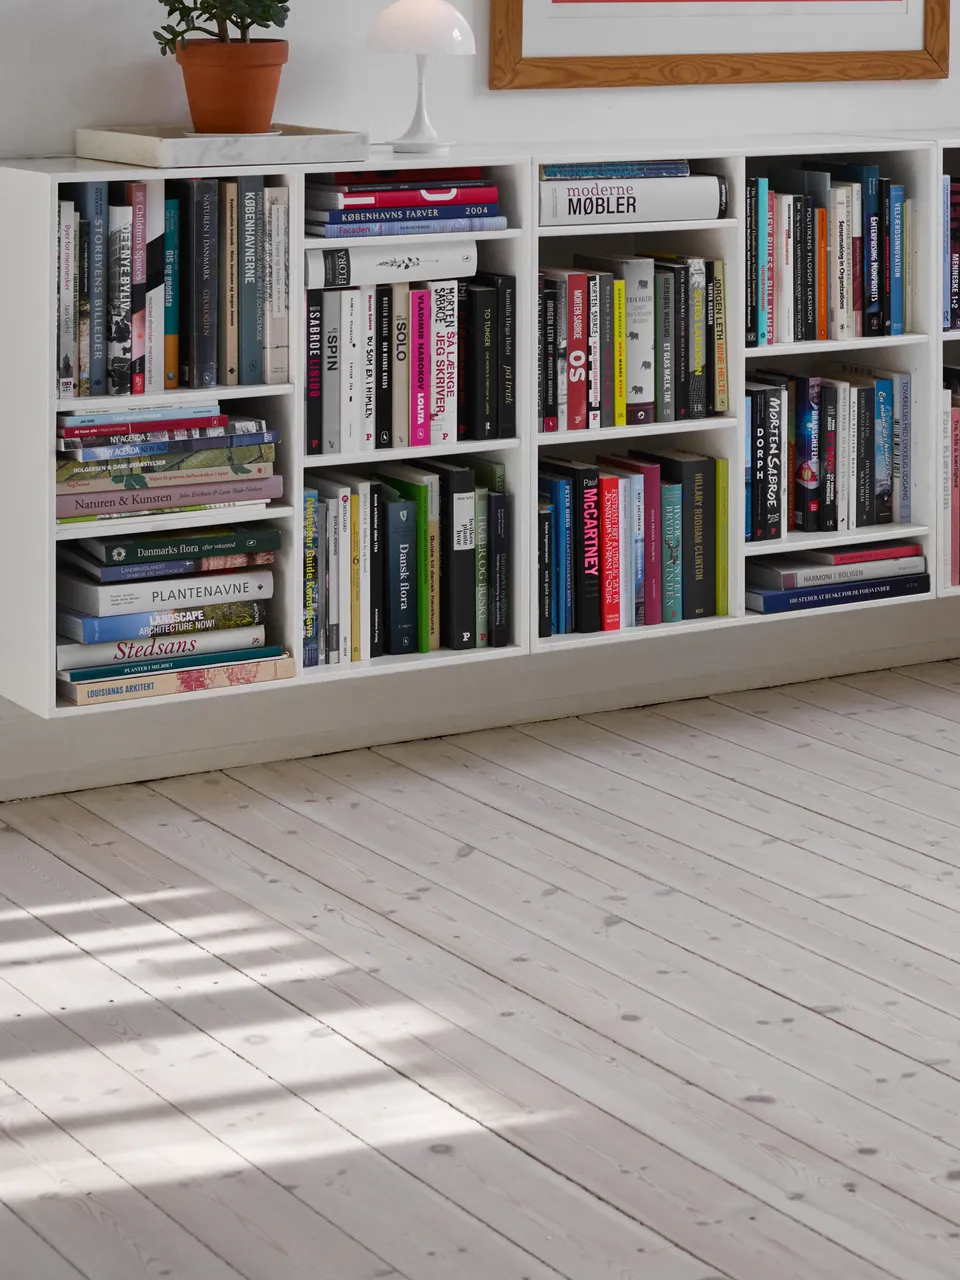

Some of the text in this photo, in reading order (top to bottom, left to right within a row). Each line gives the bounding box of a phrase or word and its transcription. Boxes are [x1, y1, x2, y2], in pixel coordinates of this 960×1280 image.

[567, 183, 634, 197] moderne
[568, 196, 637, 215] MØBLER
[339, 226, 371, 234] Facaden
[341, 207, 488, 221] KØBENHAVNS FARVER 2004
[63, 224, 72, 291] Byer for mennesker
[134, 205, 144, 281] Children's Spaces
[165, 250, 174, 262] GIS
[244, 192, 255, 284] KØBENHAVNERNE
[838, 220, 846, 259] Sensemaking
[120, 224, 131, 310] DET NYE BYLIV
[337, 250, 347, 284] FLORA
[94, 219, 103, 359] STORBYENS BILLEDER
[164, 276, 173, 307] geodata
[434, 287, 446, 324] SABROE
[444, 287, 455, 328] MORTEN
[714, 276, 722, 315] JØRGEN
[837, 268, 846, 310] Organizations
[951, 295, 959, 309] 1+2
[64, 317, 72, 334] Gehl
[484, 308, 491, 319] TO
[309, 312, 320, 397] SABROE LIBIDO
[327, 335, 338, 371] SPIN
[396, 322, 406, 361] SOLO
[569, 289, 586, 383] MORTEN SABROE OS
[694, 323, 702, 375] LARSSON
[435, 332, 445, 413] JEG SKRIVER
[446, 331, 456, 398] SÅ LÆNGE
[767, 397, 780, 508] MORTEN SABROE
[75, 493, 172, 510] Naturen & Kunsten
[604, 490, 612, 533] JONATHAN
[461, 524, 469, 545] plante
[583, 488, 599, 576] McCARTNEY
[694, 473, 703, 580] HILLARY RODHAM CLINTON
[305, 497, 315, 637] Arkitektur Guide København
[399, 543, 410, 610] Dansk flora
[478, 516, 487, 622] TRÆER OG BUSKE
[152, 582, 250, 602] PLANTENAVNE
[138, 619, 215, 636] ARCHITECTURE NOW!
[149, 610, 204, 624] LANDSCAPE
[113, 638, 197, 661] Stedsans
[87, 682, 155, 699] LOUISIANAS ARKITEKT
